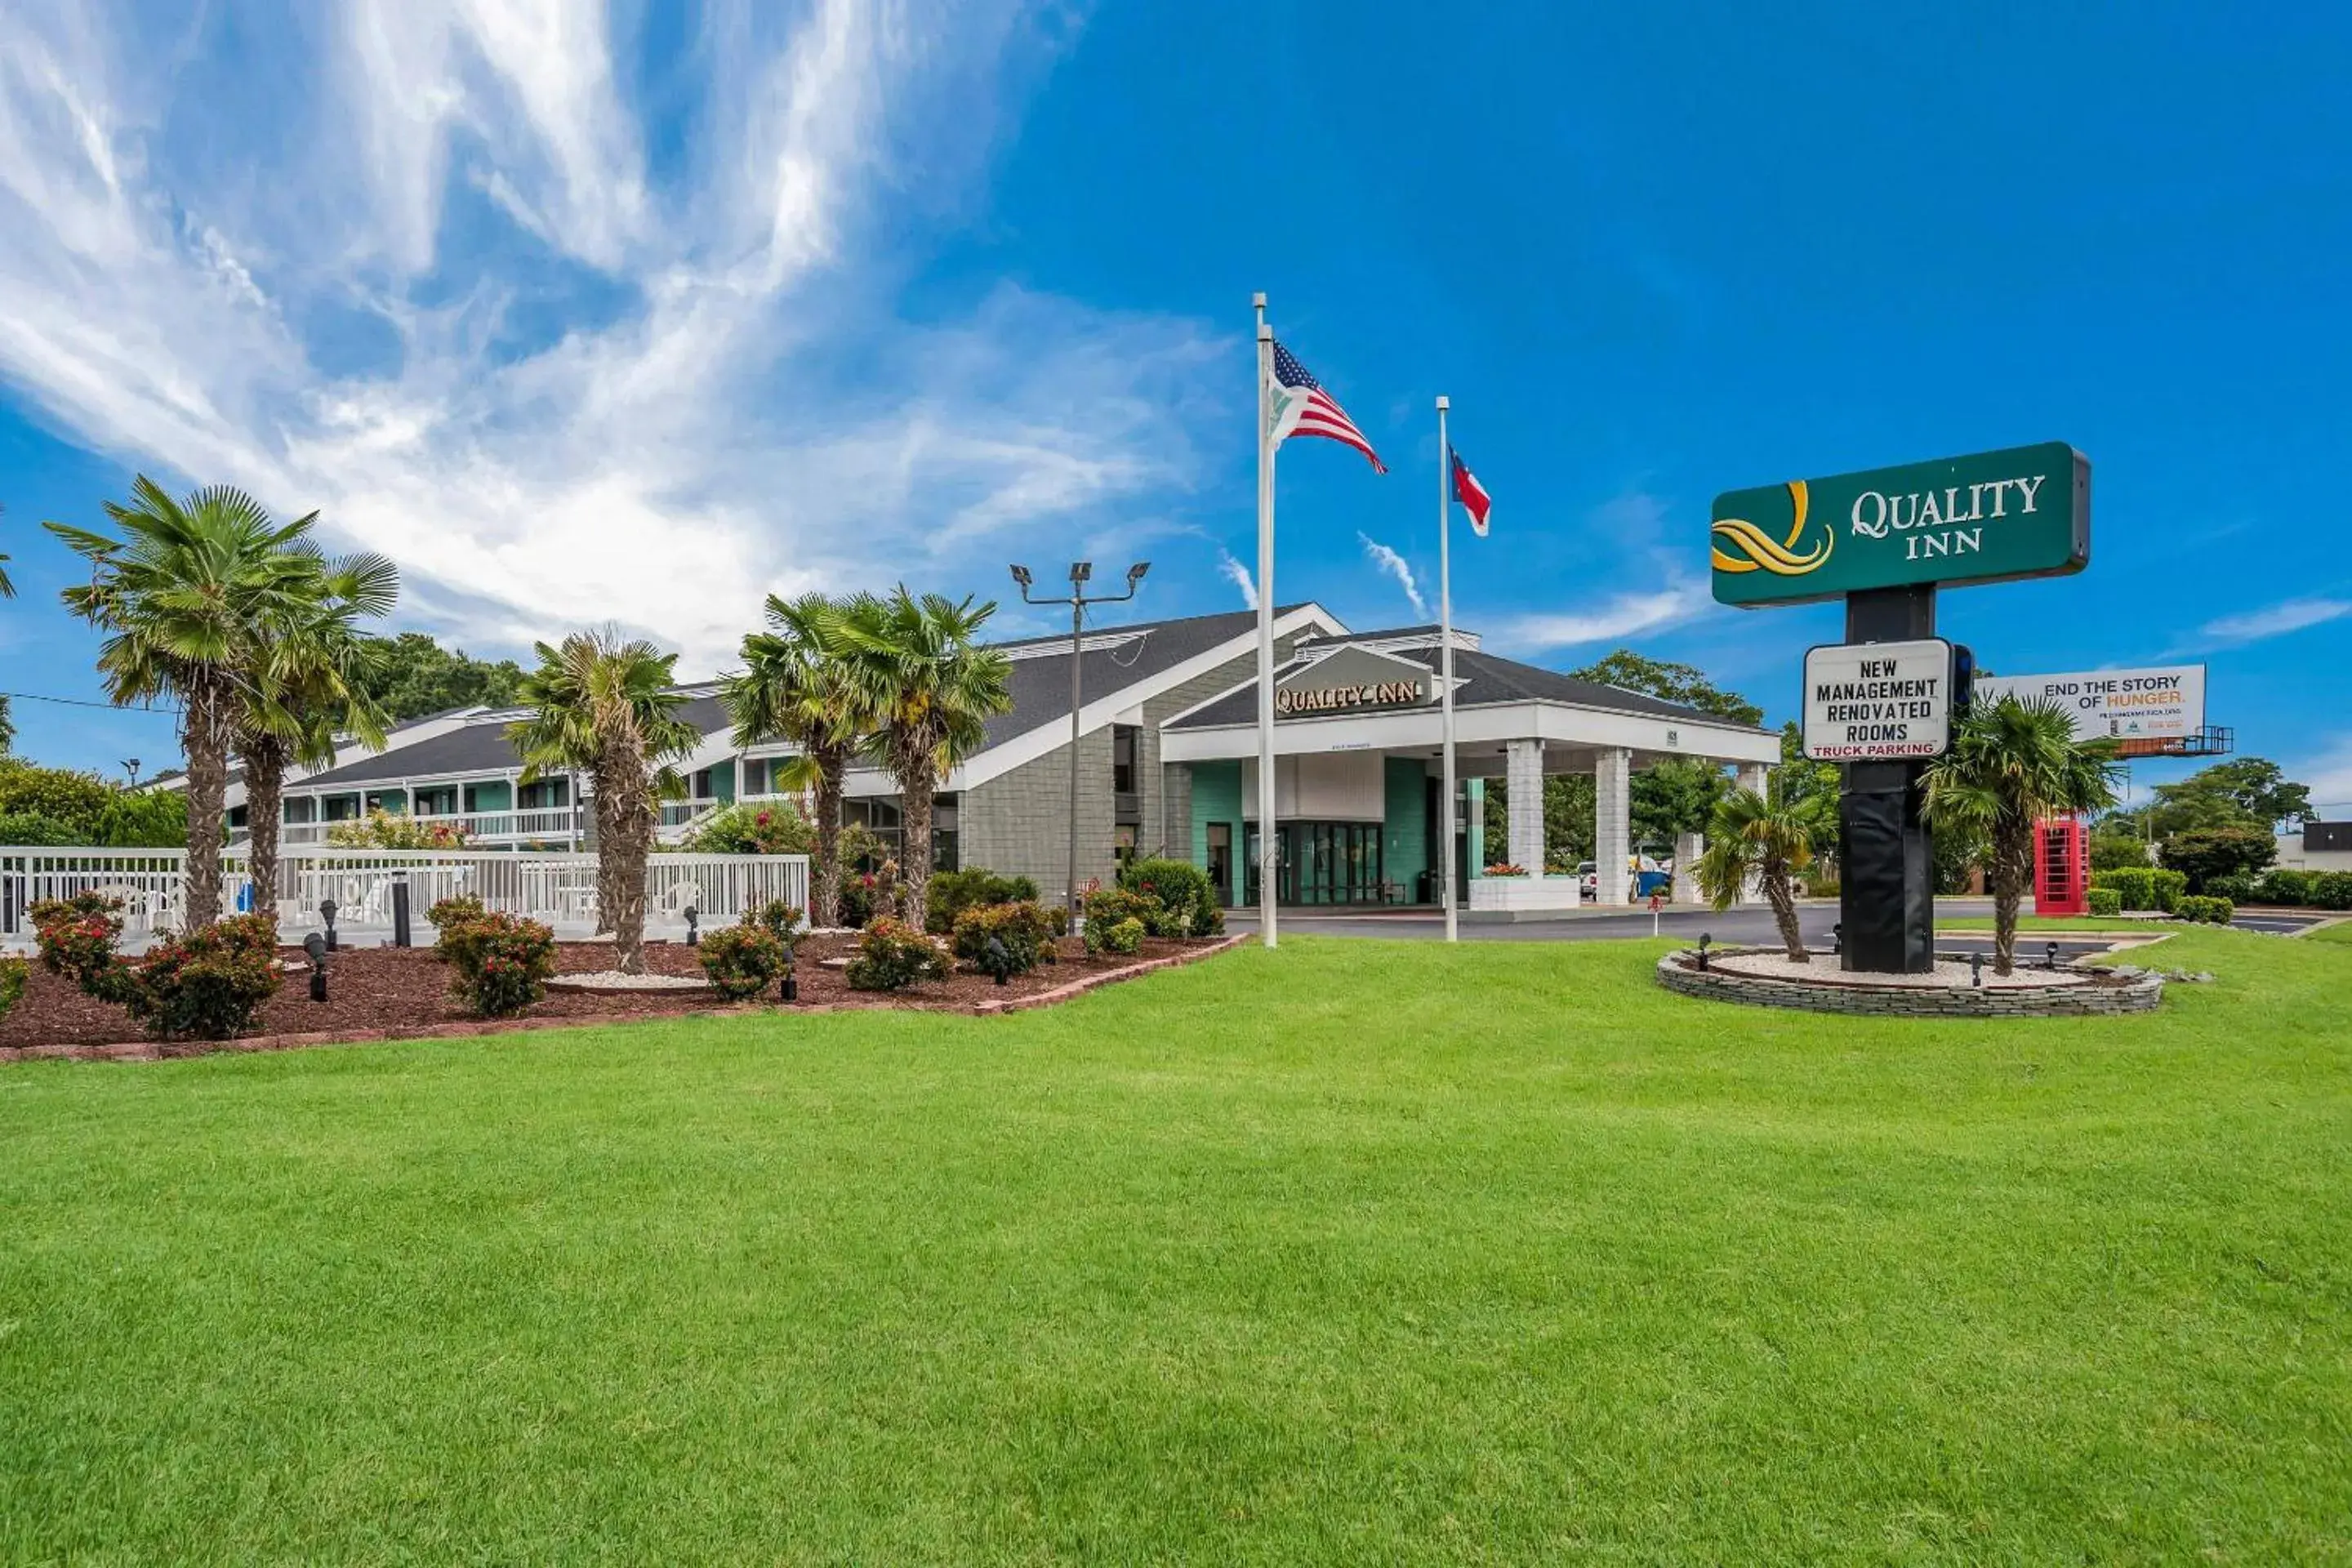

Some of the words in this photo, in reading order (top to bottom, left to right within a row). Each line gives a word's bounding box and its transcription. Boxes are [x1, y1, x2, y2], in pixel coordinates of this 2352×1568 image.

[1851, 474, 2046, 539] QUALITY
[1905, 528, 1982, 560] INN
[1860, 660, 1896, 679] NEW
[1276, 685, 1365, 713] QUALITY
[1372, 680, 1416, 703] INN
[1817, 679, 1937, 702] MANAGEMENT
[2045, 683, 2079, 697] END
[2084, 680, 2117, 693] THE
[2123, 675, 2181, 692] STORY
[2079, 697, 2101, 709] OF
[2107, 691, 2185, 707] HUNGER.
[1828, 701, 1931, 722] RENOVATED
[1847, 724, 1908, 742] ROOMS
[1814, 746, 1862, 756] TRUCK
[1868, 744, 1933, 754] PARKING
